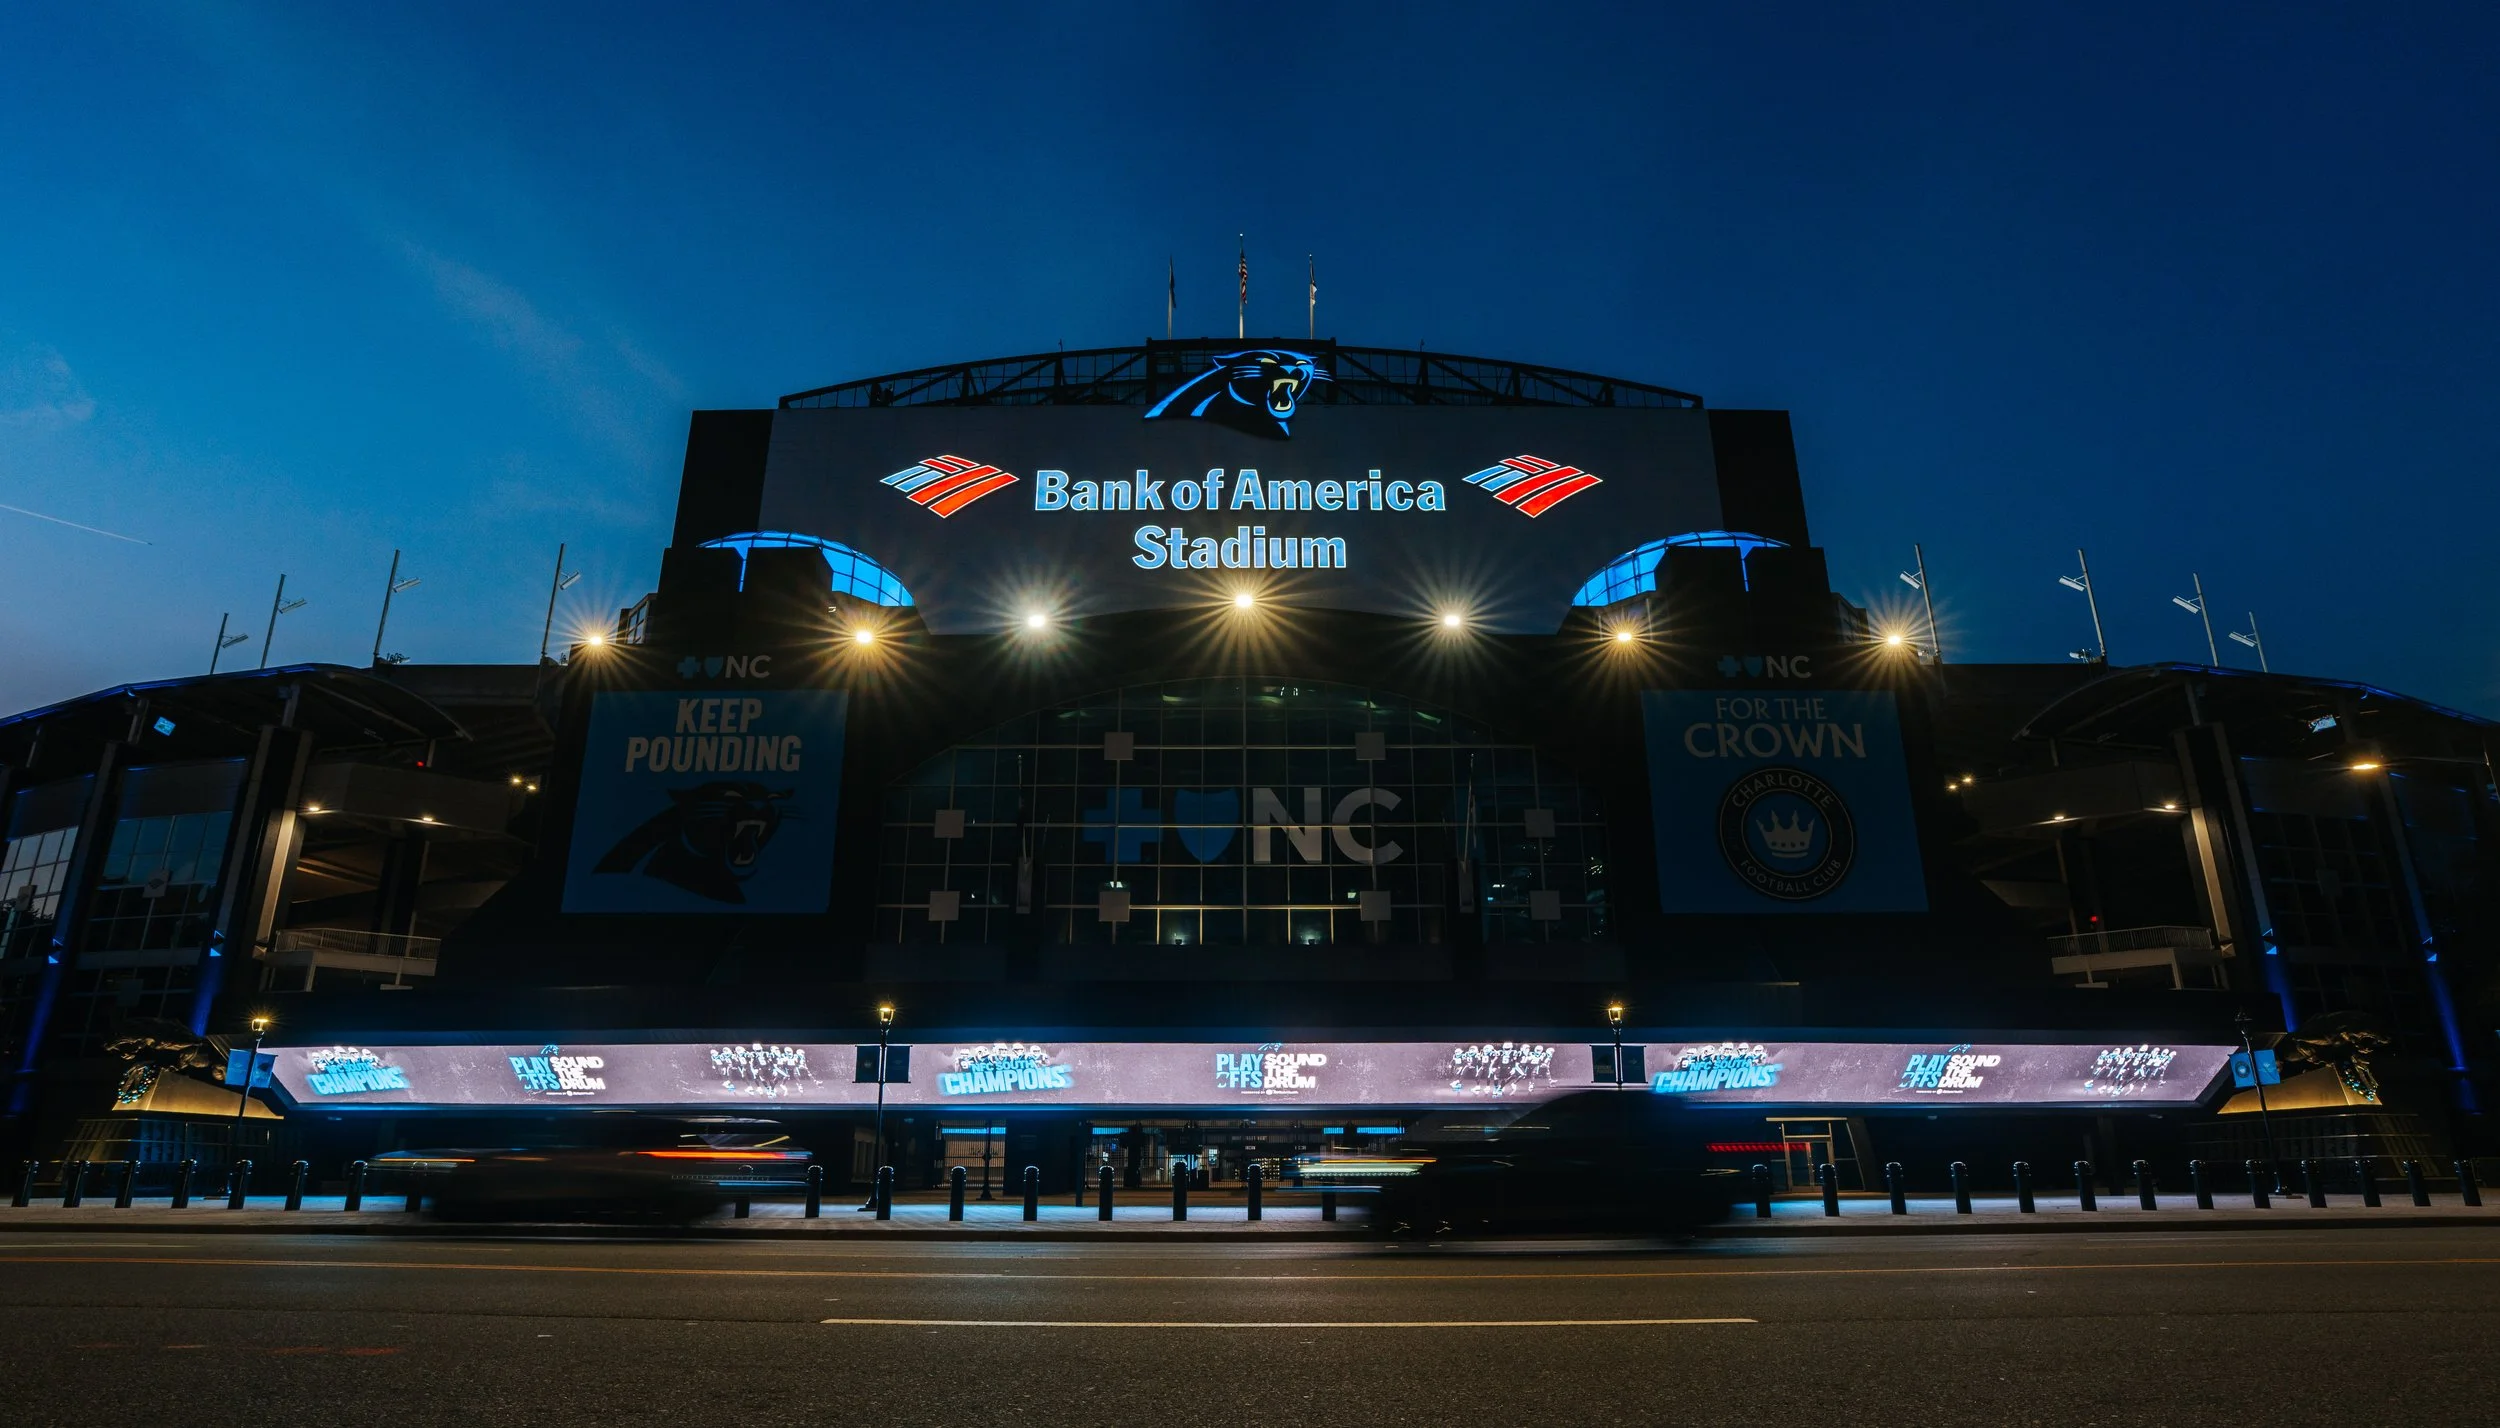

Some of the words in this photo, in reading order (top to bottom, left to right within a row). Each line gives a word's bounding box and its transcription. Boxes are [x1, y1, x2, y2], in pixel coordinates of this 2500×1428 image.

[1035, 469, 1165, 511] Bank
[1171, 468, 1224, 511] of
[1230, 469, 1446, 511] America
[1132, 525, 1346, 569] Stadium
[725, 655, 772, 678] NC
[1767, 655, 1812, 678] NC
[675, 698, 762, 733] KEEP
[1715, 697, 1769, 720] FOR
[1774, 697, 1827, 720] THE
[1684, 722, 1867, 758] CROWN
[624, 735, 803, 773] POUNDING
[1732, 773, 1834, 808] CHARLOTTE
[1253, 786, 1403, 864] NC
[1740, 860, 1810, 892] FOOTBALL
[1813, 859, 1841, 886] CLUB
[509, 1057, 551, 1074] PLAY
[550, 1056, 604, 1068] SOUND
[972, 1061, 994, 1072] NFC
[996, 1059, 1034, 1071] SOUTH
[1216, 1053, 1264, 1071] PLAY
[1264, 1053, 1327, 1066] SOUND
[1689, 1060, 1712, 1071] NFC
[1714, 1058, 1751, 1070] SOUTH
[1906, 1054, 1951, 1072] PLAY
[1949, 1054, 2001, 1067] SOUND
[311, 1067, 405, 1095] CHAMPIONS
[553, 1068, 587, 1079] THE
[945, 1066, 1067, 1095] CHAMPIONS
[1264, 1065, 1299, 1077] THE
[1656, 1065, 1775, 1093] CHAMPIONS
[1945, 1065, 1976, 1077] THE
[559, 1078, 606, 1089] DRUM
[1264, 1076, 1316, 1088] DRUM
[1937, 1076, 1984, 1088] DRUM
